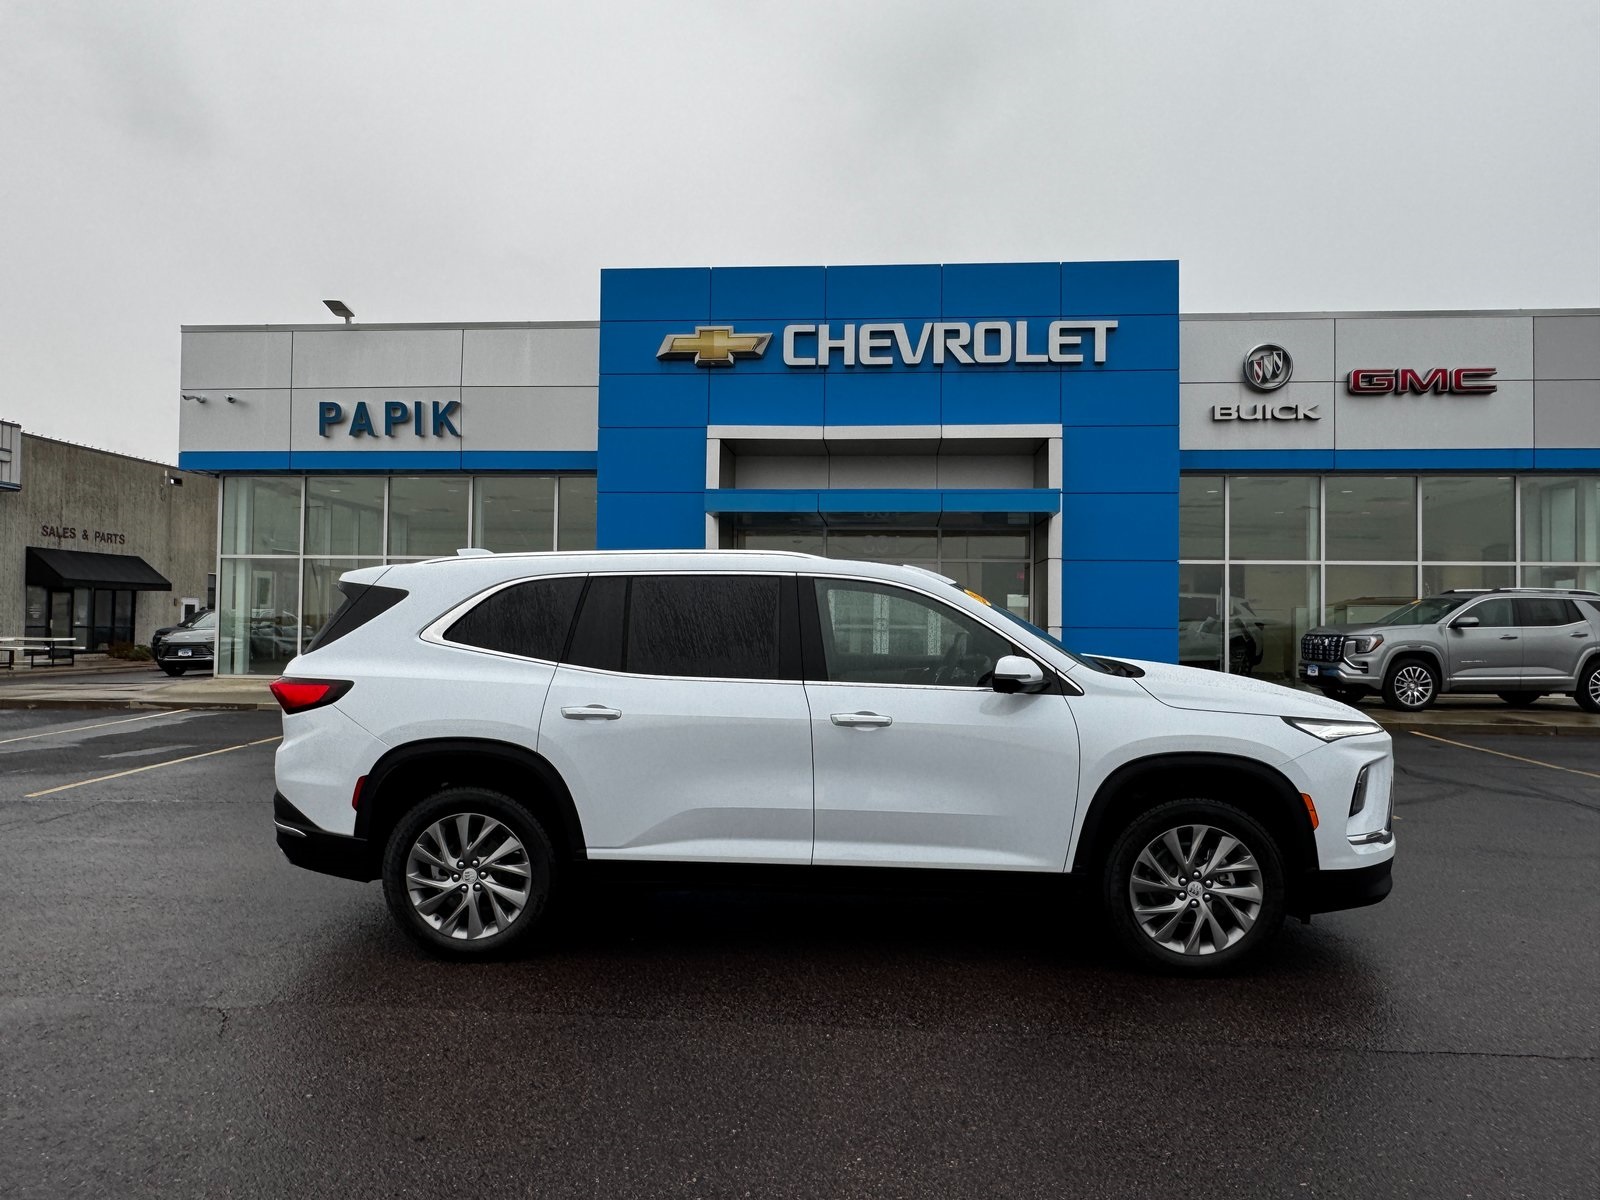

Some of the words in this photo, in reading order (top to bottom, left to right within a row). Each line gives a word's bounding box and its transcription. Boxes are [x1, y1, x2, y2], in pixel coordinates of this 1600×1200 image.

[783, 320, 1118, 366] CHEVROLET
[1348, 368, 1497, 395] GMC
[318, 400, 461, 438] PAPIK
[1212, 403, 1322, 421] BUICK
[41, 524, 77, 539] SALES
[81, 529, 89, 541] &
[94, 531, 126, 545] PARTS
